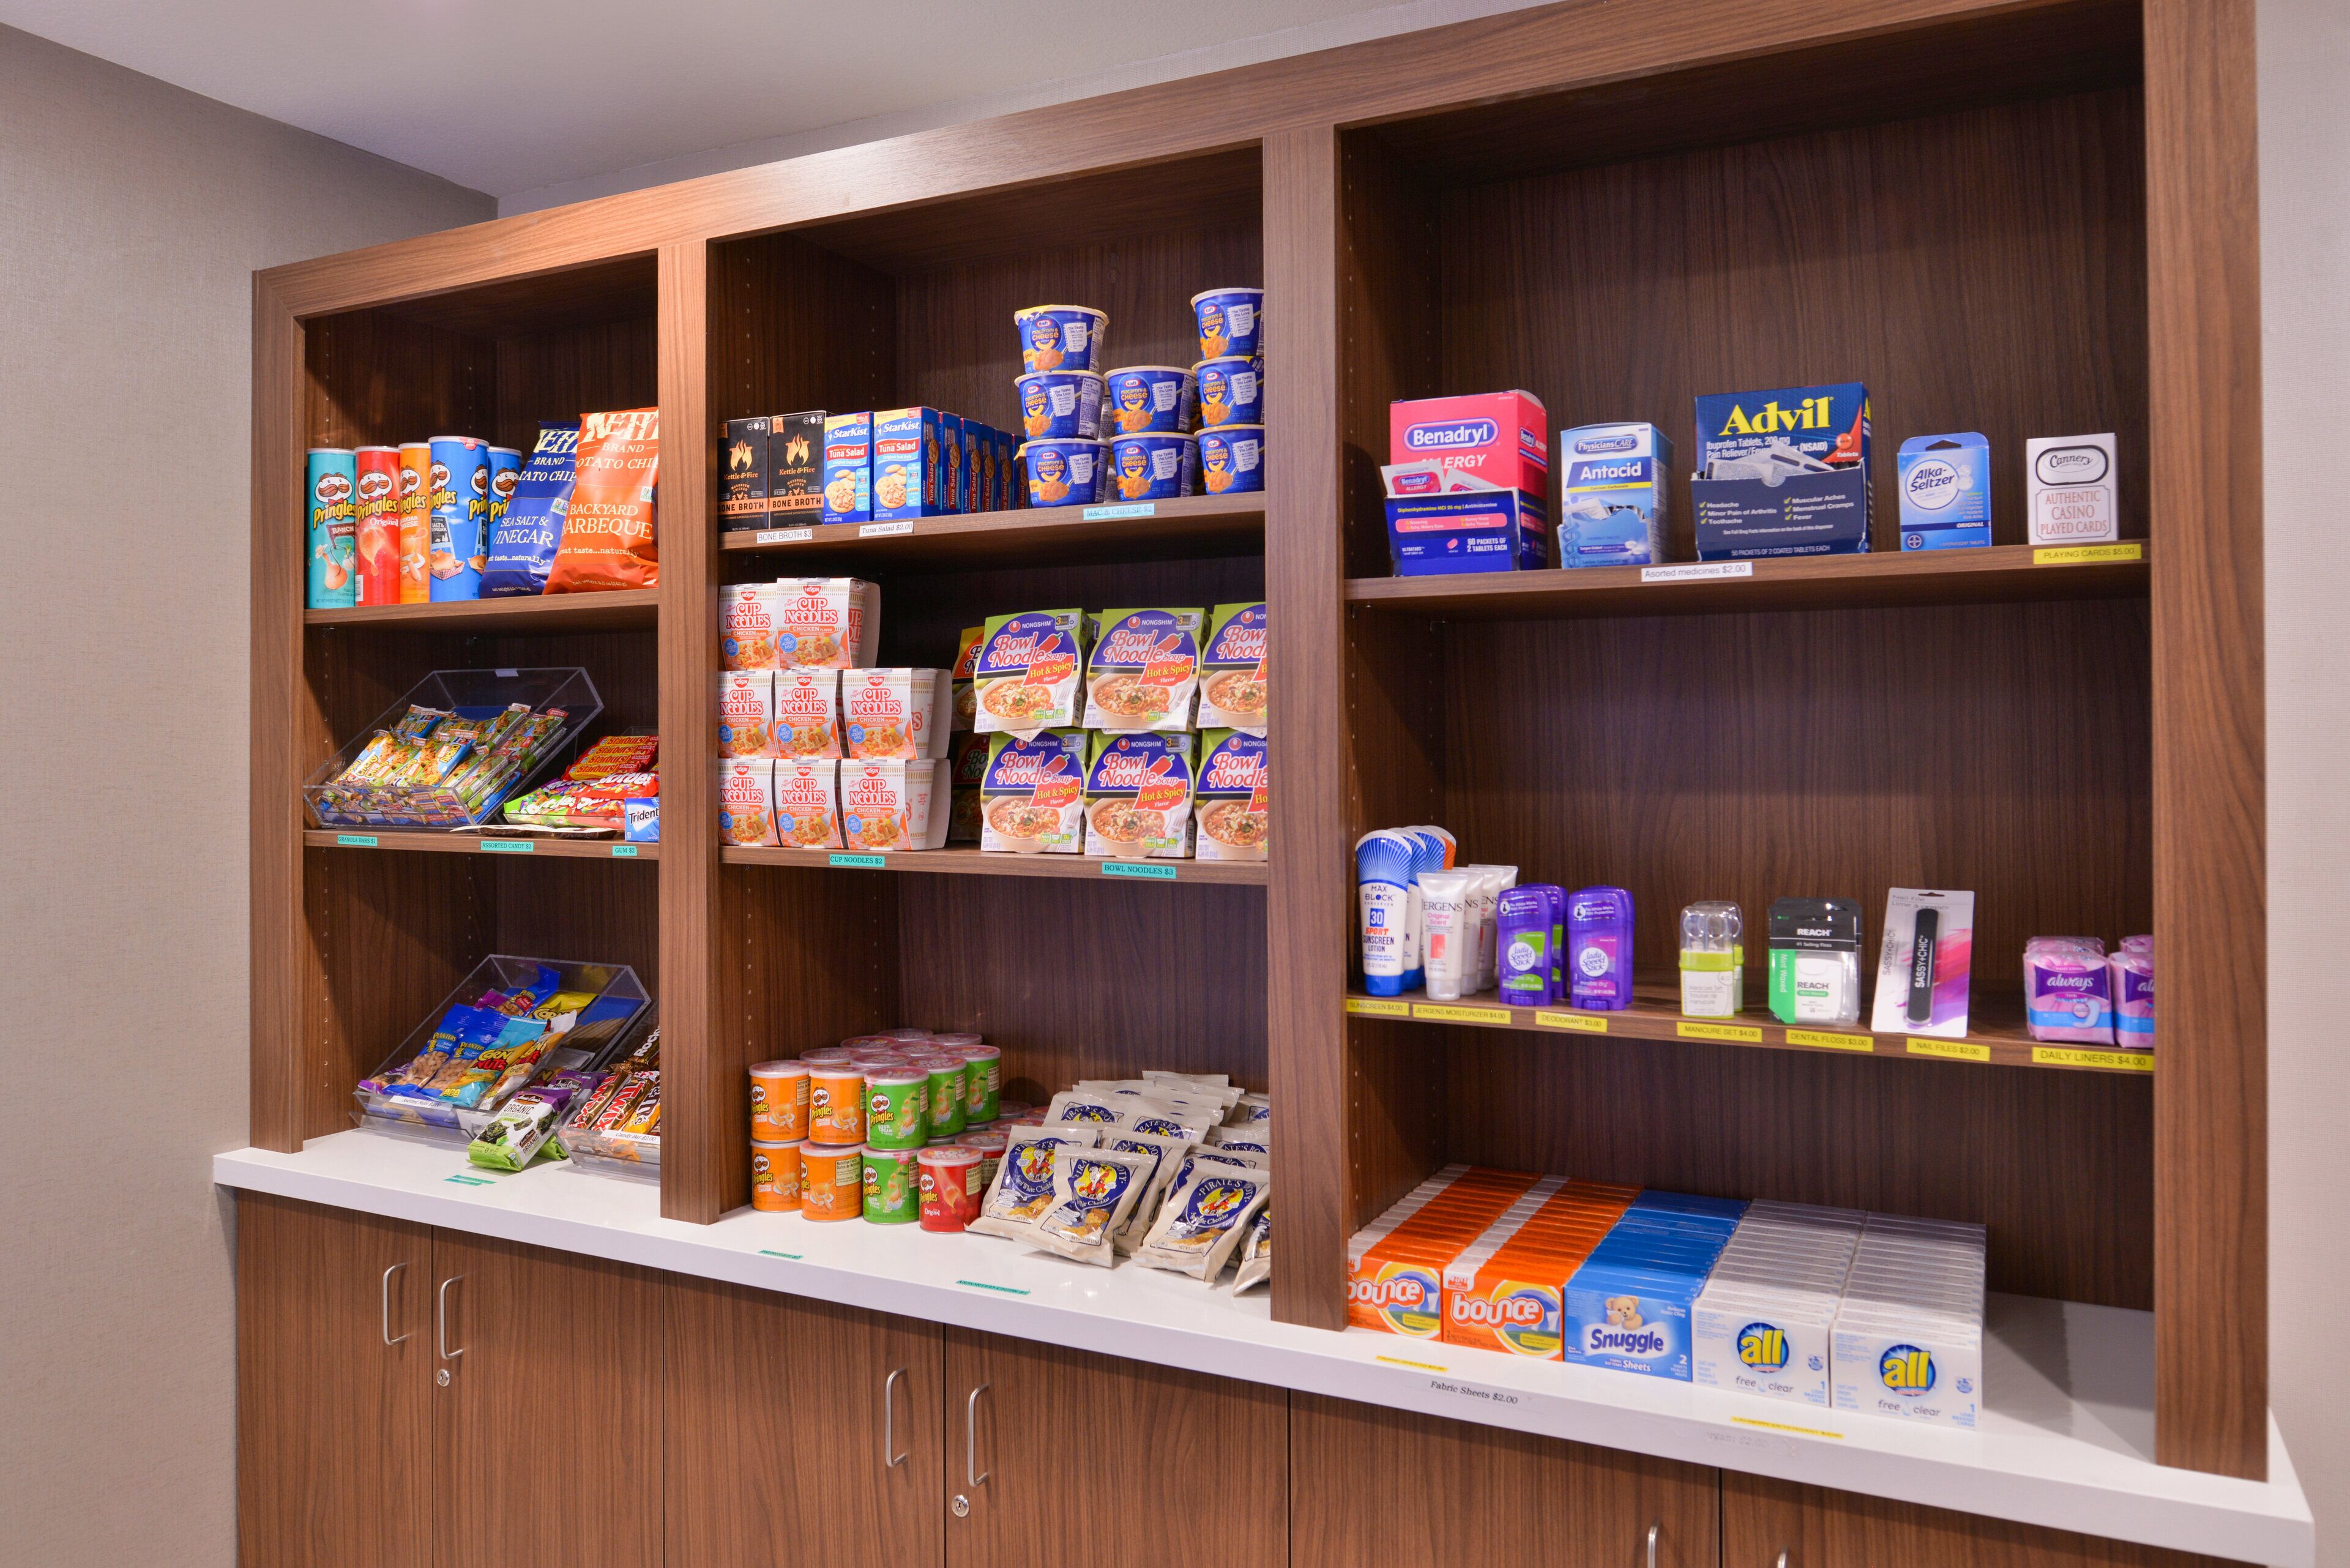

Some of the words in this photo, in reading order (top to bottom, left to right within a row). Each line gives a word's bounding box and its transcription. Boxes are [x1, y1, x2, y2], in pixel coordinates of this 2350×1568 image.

[1718, 397, 1830, 436] Advil
[834, 428, 868, 438] StarKist
[1414, 424, 1488, 446] Benadryl
[602, 442, 644, 453] BRAND
[1578, 439, 1633, 451] PhysiciansCARE
[1706, 439, 1737, 450] Ibuprofen
[1738, 438, 1764, 447] Tablets,
[1800, 441, 1828, 452] (NSAID)
[846, 447, 864, 456] Salad
[2050, 455, 2093, 468] Cannery
[1580, 461, 1641, 480] Antacid
[1913, 468, 1947, 482] Alka-
[1911, 475, 1955, 492] Seltzer
[772, 499, 791, 508] BONE
[2045, 490, 2100, 505] AUTHENTIC
[313, 500, 356, 530] Pringles
[357, 495, 398, 526] Pringles
[570, 504, 638, 516] BACKYARD
[2051, 505, 2095, 520] CASINO
[370, 518, 398, 527] Original
[501, 518, 513, 527] SEA
[515, 516, 538, 526] SALT
[539, 517, 548, 526] &
[2041, 522, 2073, 535] PLAYED
[2076, 520, 2107, 532] CARDS
[332, 525, 355, 534] RANCH
[562, 518, 653, 540] BARBEQUE
[758, 532, 777, 541] BONE
[1679, 567, 1720, 575] medicines
[1722, 565, 1745, 573] $2.00
[797, 597, 828, 611] CUP
[785, 610, 838, 624] NOODLES
[994, 632, 1039, 652] Bowl
[988, 649, 1045, 668] Noodle
[1045, 652, 1065, 662] Soup
[1030, 669, 1045, 678] Hot
[1053, 662, 1072, 673] Spicy
[576, 764, 619, 774] Starburst
[628, 808, 658, 824] Trident
[1422, 899, 1462, 912] JERGENS
[1371, 911, 1384, 924] 30
[1363, 936, 1394, 944] SUNSCREEN
[2047, 973, 2094, 991] always
[1446, 1009, 1488, 1018] MOISTURIZER
[1542, 1015, 1583, 1025] DEODORANT
[1585, 1019, 1602, 1028] $3.00
[1685, 1026, 1721, 1034] MANICURE
[433, 1032, 457, 1042] PLANTERS
[1822, 1035, 1846, 1043] FLOSS
[1848, 1038, 1868, 1047] $3.00
[477, 1050, 513, 1061] CORN
[1960, 1047, 1980, 1055] $2.00
[473, 1059, 507, 1070] NUTS
[2041, 1051, 2071, 1061] DAILY
[2075, 1054, 2114, 1063] LINERS
[2118, 1056, 2146, 1066] $4.00
[504, 1104, 534, 1114] ORGANIC
[870, 1110, 894, 1128] Pringles
[1199, 1179, 1242, 1195] PIRATE'S
[1087, 1197, 1110, 1207] Cheddar
[1453, 1294, 1539, 1324] bounce
[1591, 1329, 1664, 1354] Snuggle
[1740, 1329, 1785, 1365] all
[1623, 1360, 1651, 1372] Sheets
[1736, 1376, 1756, 1387] free
[1769, 1383, 1794, 1394] clear
[1431, 1381, 1458, 1393] Fabric
[1460, 1387, 1490, 1398] Sheets
[1493, 1393, 1518, 1404] $2.00
